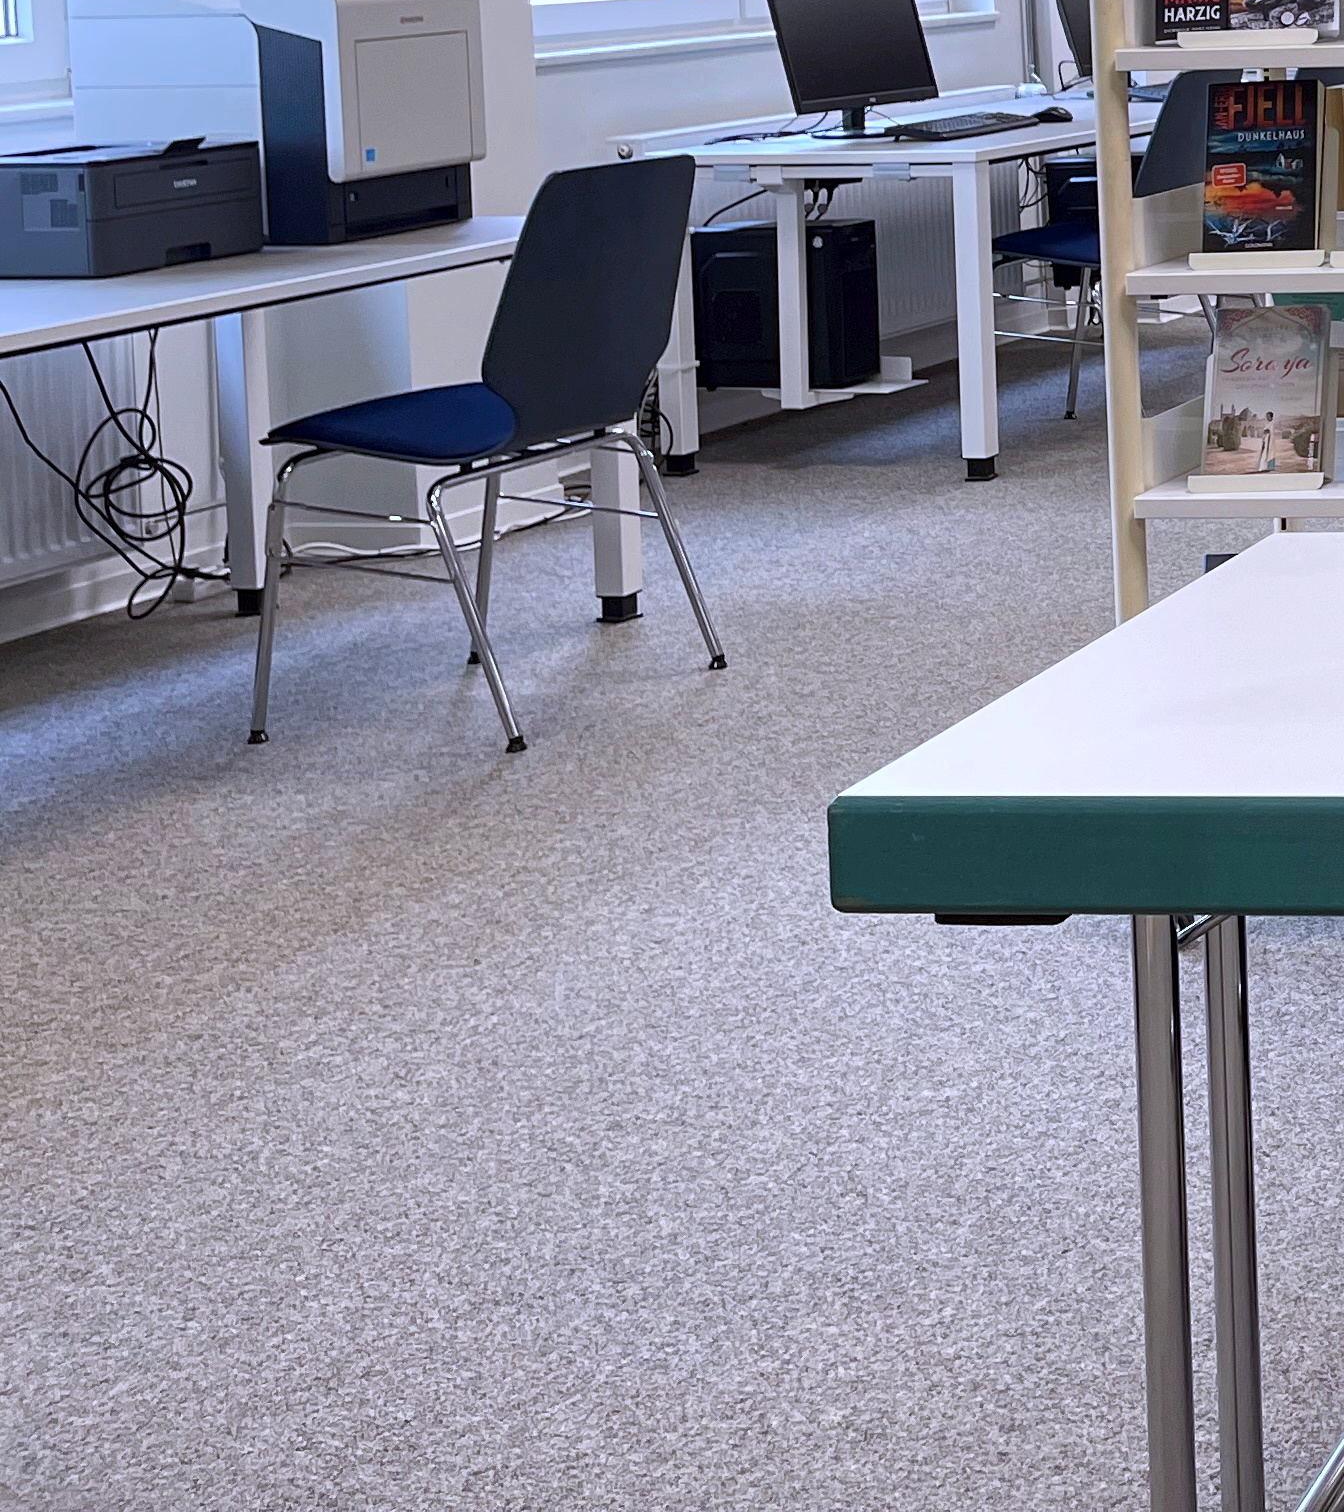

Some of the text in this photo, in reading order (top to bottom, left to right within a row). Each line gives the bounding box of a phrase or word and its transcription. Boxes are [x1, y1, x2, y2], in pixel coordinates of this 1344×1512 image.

[1164, 5, 1220, 23] HARZIG
[1228, 84, 1308, 130] FJELL
[1237, 130, 1305, 142] DUNKELHAUS
[1220, 347, 1312, 379] Soraya
